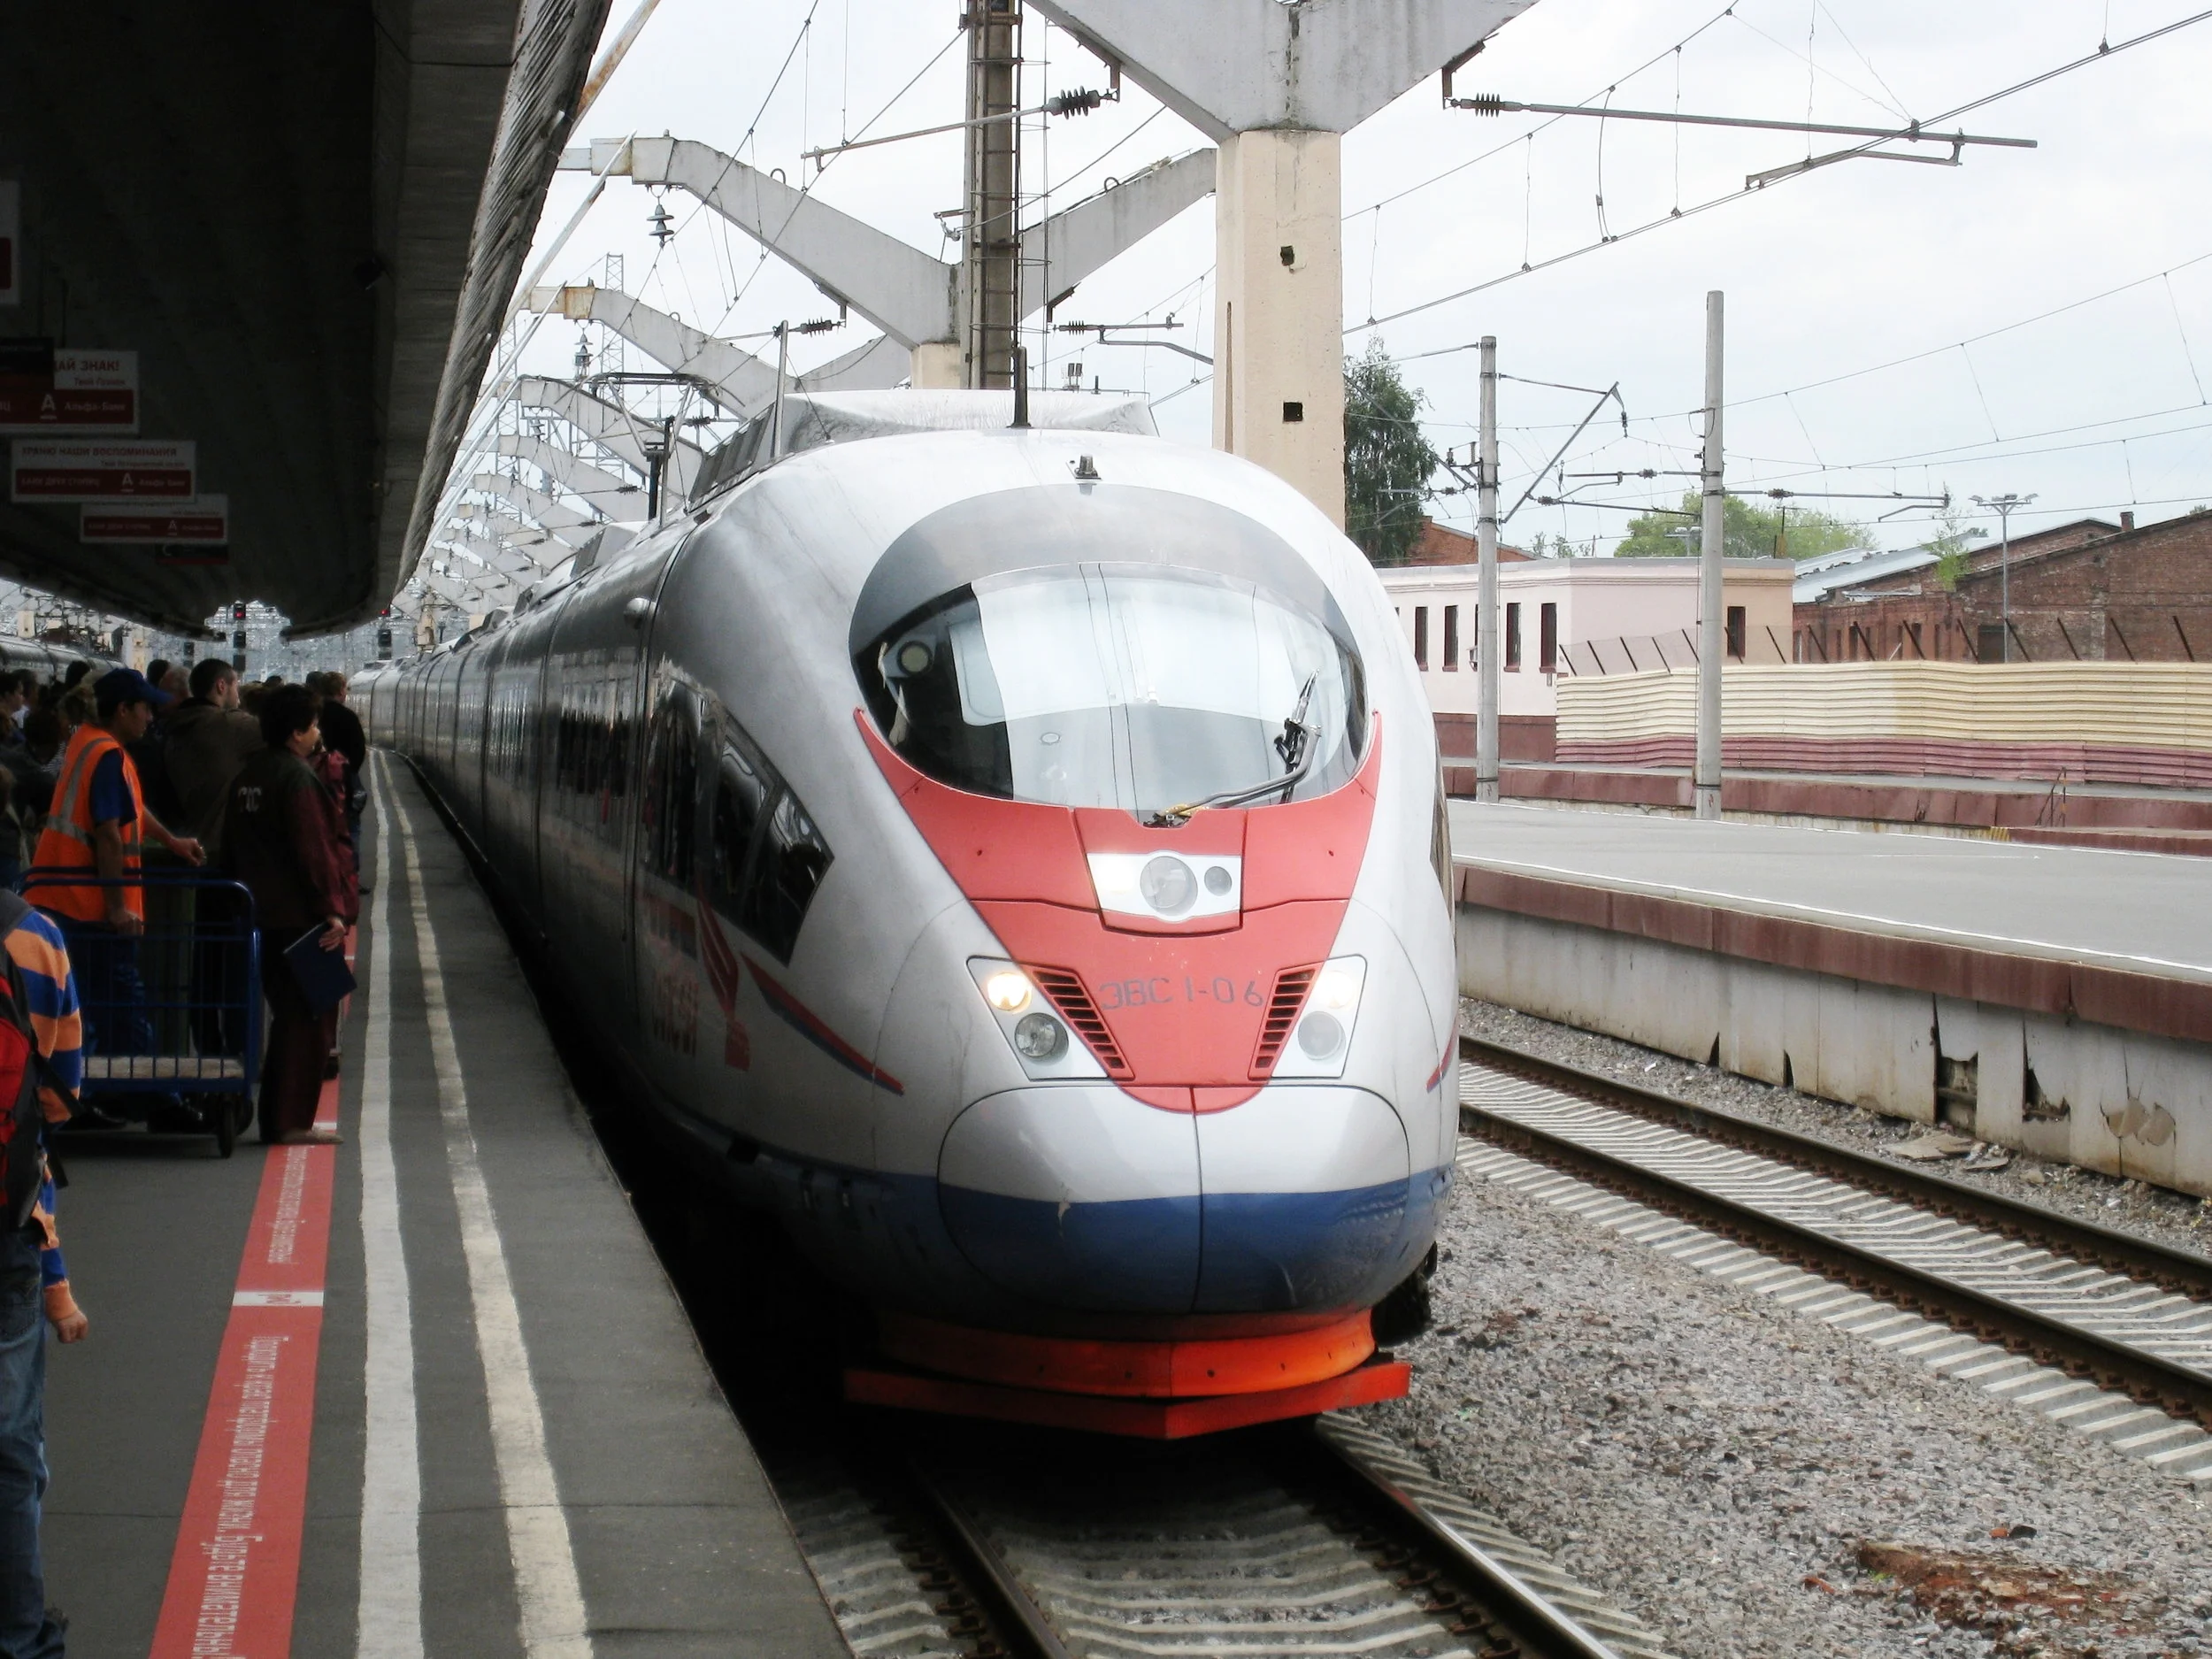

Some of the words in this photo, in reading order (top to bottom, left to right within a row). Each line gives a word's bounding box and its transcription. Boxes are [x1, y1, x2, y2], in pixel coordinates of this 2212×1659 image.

[80, 359, 119, 372] ЗНАК!
[226, 1448, 265, 1478] опасно
[216, 1479, 259, 1497] для
[200, 1534, 264, 1571] Будьте
